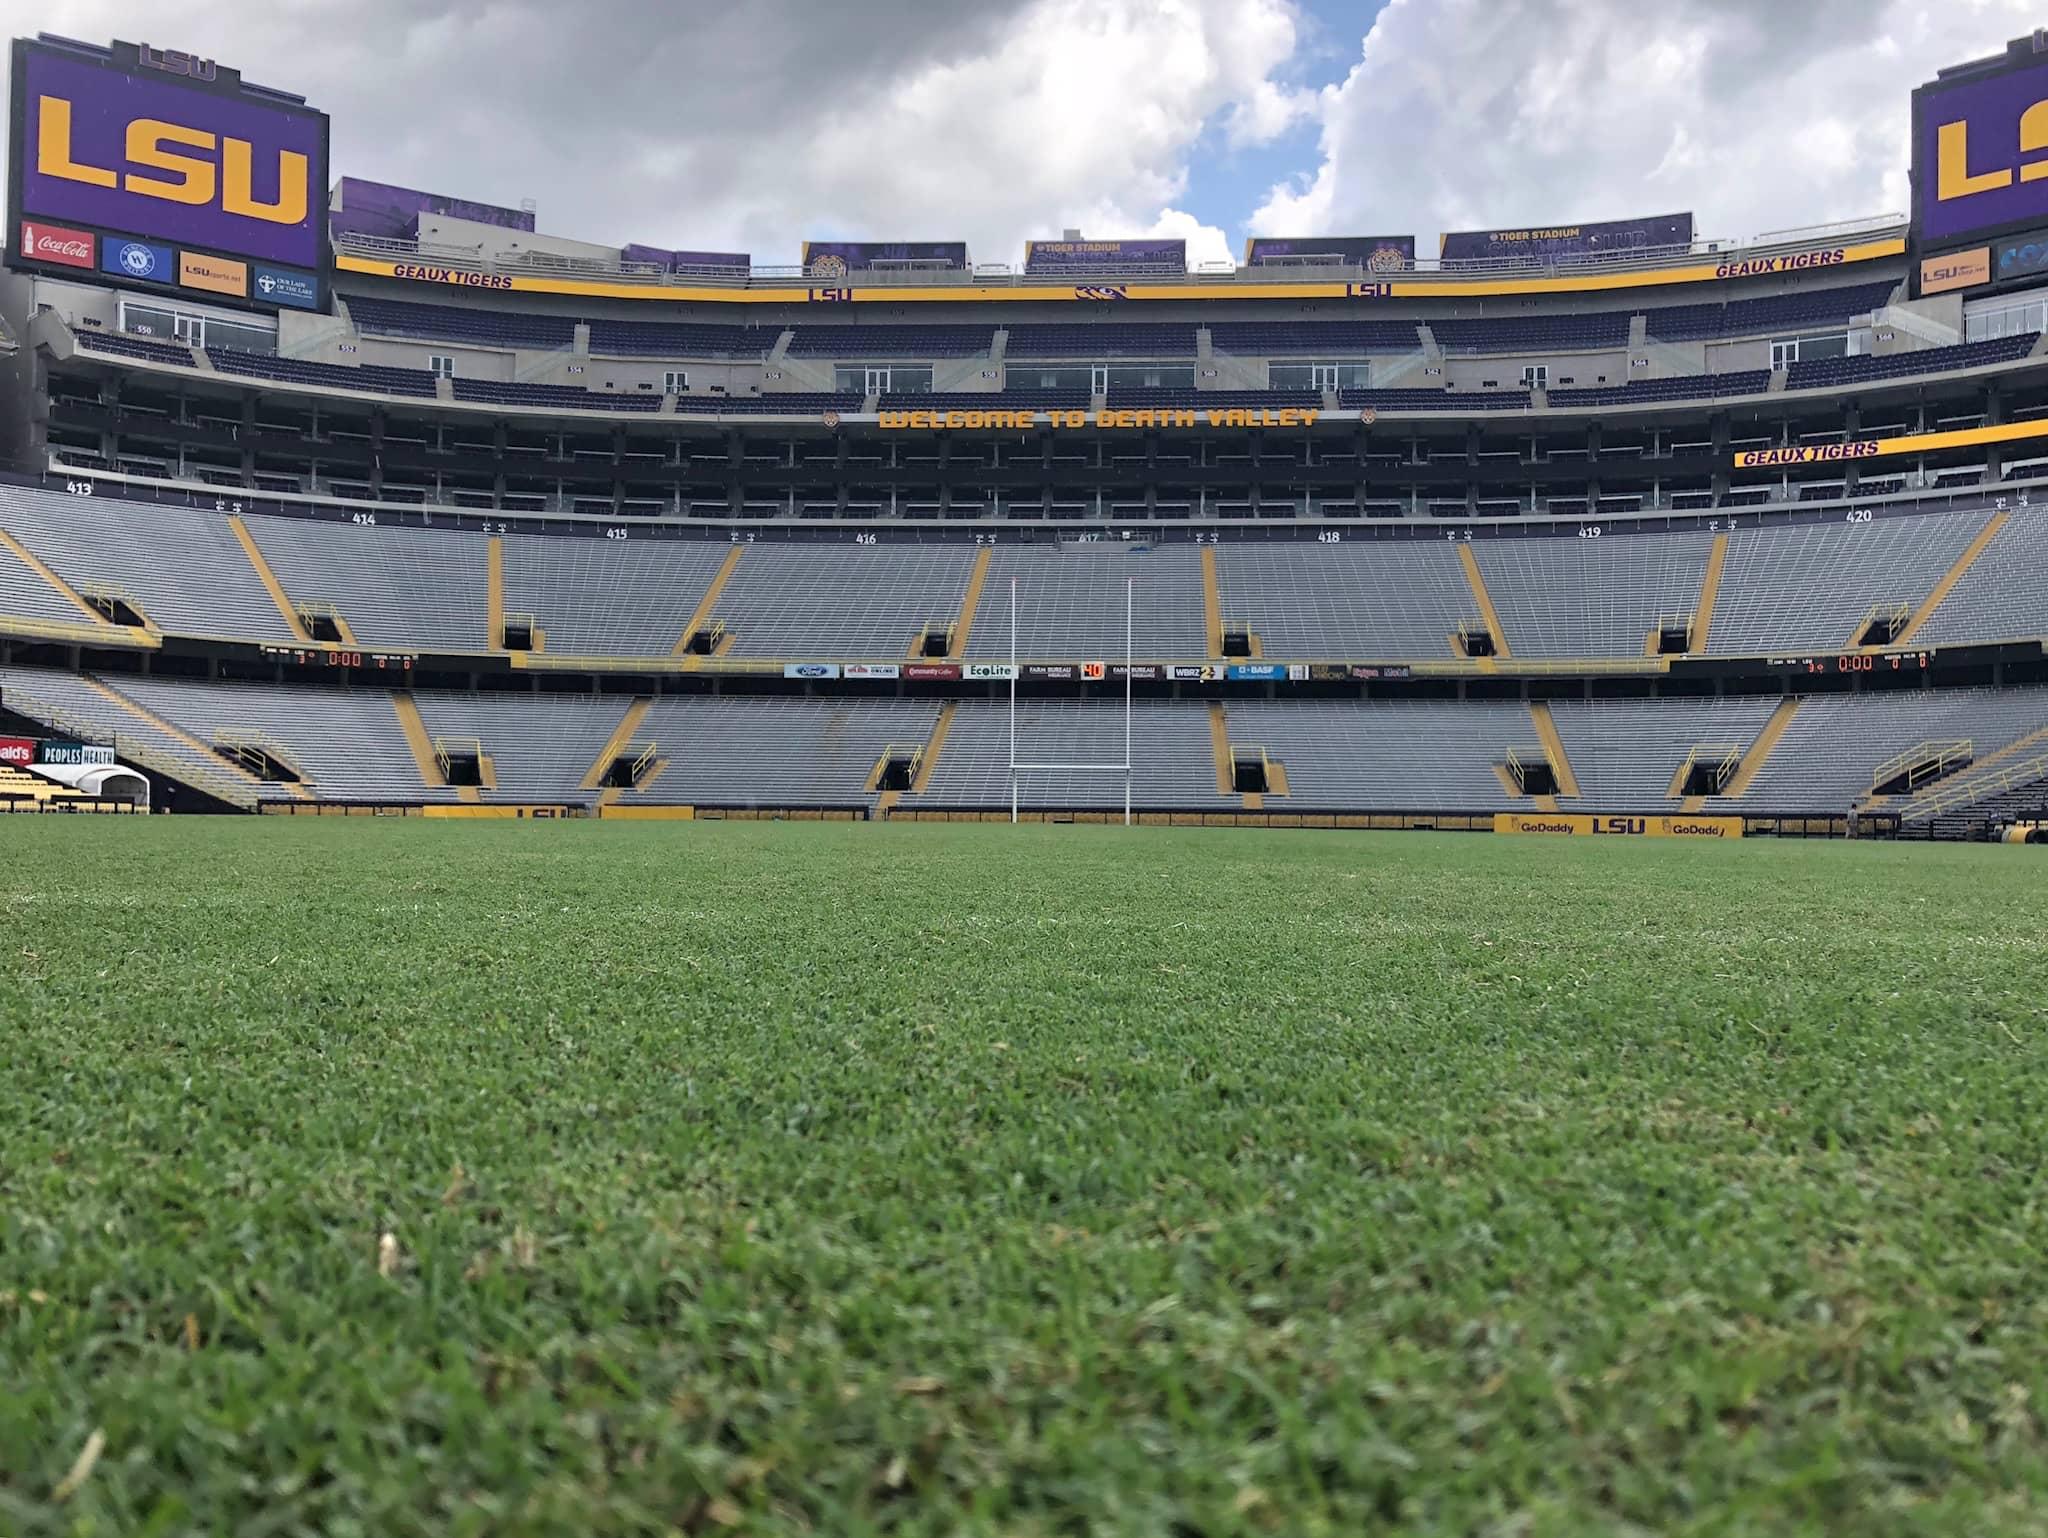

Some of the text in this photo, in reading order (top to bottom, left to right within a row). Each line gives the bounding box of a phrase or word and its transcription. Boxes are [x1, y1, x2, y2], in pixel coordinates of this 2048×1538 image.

[139, 43, 216, 82] LSU
[37, 94, 309, 225] LSU
[1499, 228, 1580, 241] TIGER STADIUM
[1046, 243, 1121, 253] TIGER STADIUM
[1715, 249, 1845, 278] GEAUX TIGERS
[393, 264, 513, 289] GEAUX TIGERS
[1922, 266, 1958, 283] LSU
[808, 287, 852, 302] LSU
[1346, 283, 1392, 297] LSU
[879, 409, 1319, 428] WELCOME TO DEATH VALLEY
[1743, 441, 1880, 466] GEAUX TIGERS
[66, 481, 92, 496] 413
[352, 512, 376, 526] 414
[1846, 509, 1873, 523] 420
[606, 527, 628, 540] 415
[856, 532, 877, 544] 416
[1318, 531, 1341, 543] 418
[1578, 526, 1602, 539] 419
[328, 651, 361, 666] 0:00
[1838, 655, 1873, 671] 0:00
[970, 665, 1011, 675] EcoLite
[1175, 667, 1200, 677] WBRZ
[1251, 666, 1274, 675] BASF
[0, 747, 29, 760] ald's
[45, 748, 113, 765] PEOPLES HEALTH
[1521, 822, 1574, 834] GoDaddy
[1593, 818, 1646, 834] LSU
